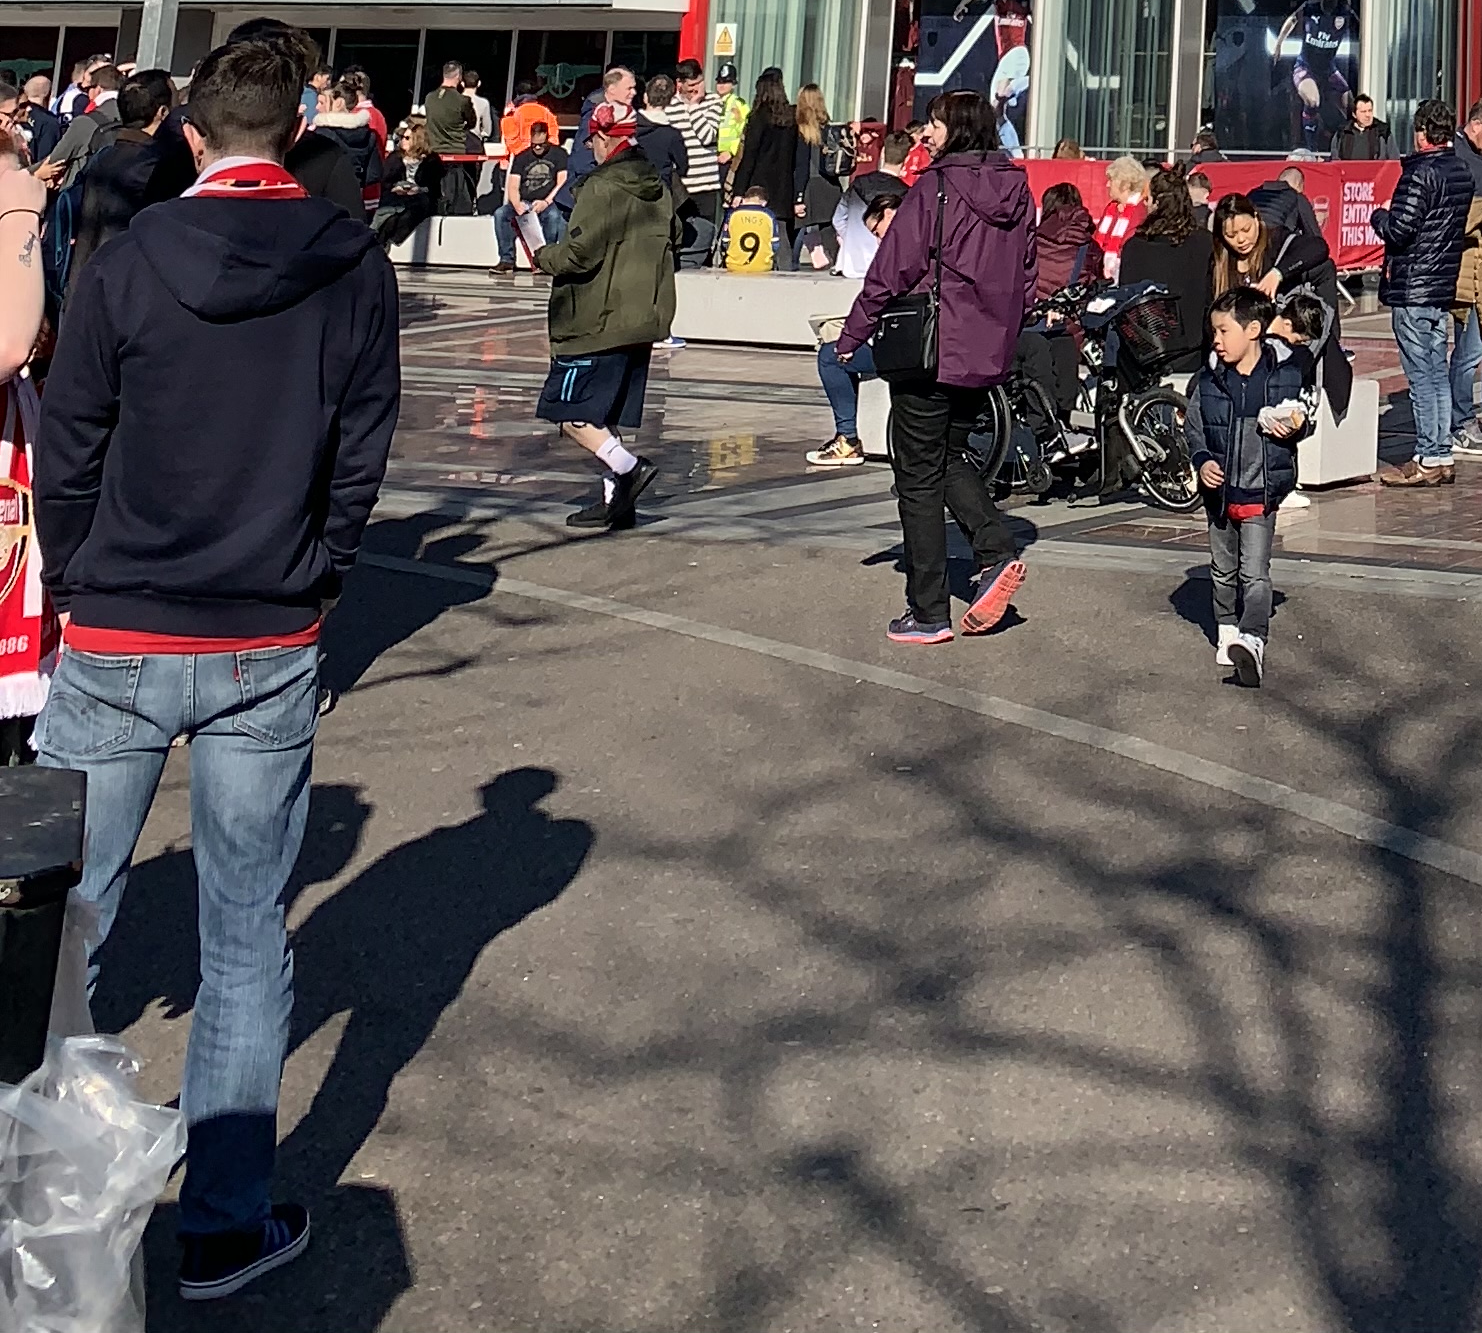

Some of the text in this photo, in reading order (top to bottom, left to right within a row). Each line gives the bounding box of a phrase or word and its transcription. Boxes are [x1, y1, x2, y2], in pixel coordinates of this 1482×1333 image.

[1343, 182, 1374, 201] STORE
[741, 216, 763, 226] INGS
[1342, 226, 1364, 246] THIS
[739, 231, 760, 265] 9
